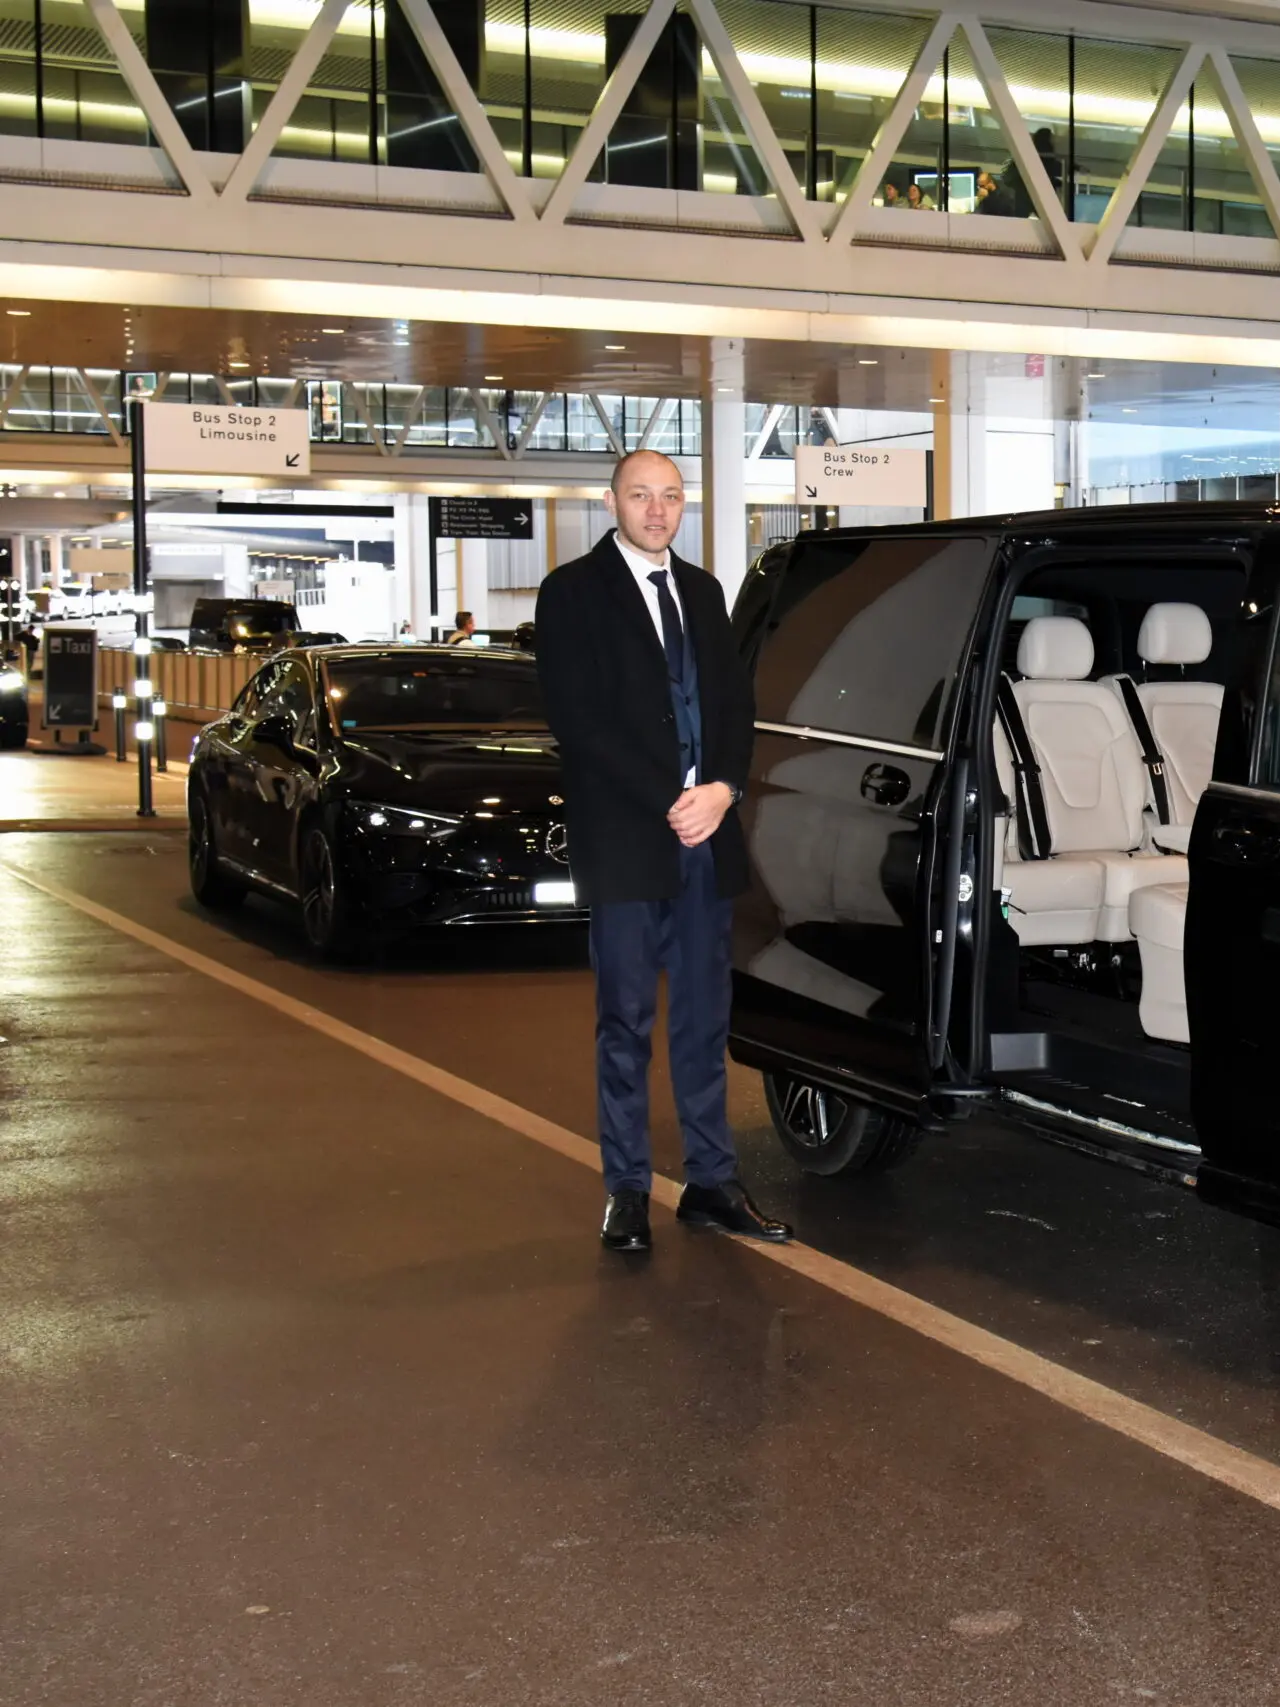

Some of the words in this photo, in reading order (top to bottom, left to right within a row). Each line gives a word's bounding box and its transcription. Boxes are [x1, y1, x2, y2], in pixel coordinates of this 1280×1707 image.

[192, 410, 221, 424] Bus
[227, 413, 262, 427] Stop
[268, 415, 276, 426] 2
[199, 427, 277, 442] Limousine
[823, 452, 846, 463] Bus
[851, 453, 879, 465] Stop
[883, 454, 890, 464] 2
[823, 466, 854, 477] Crew
[63, 638, 92, 655] Taxi
